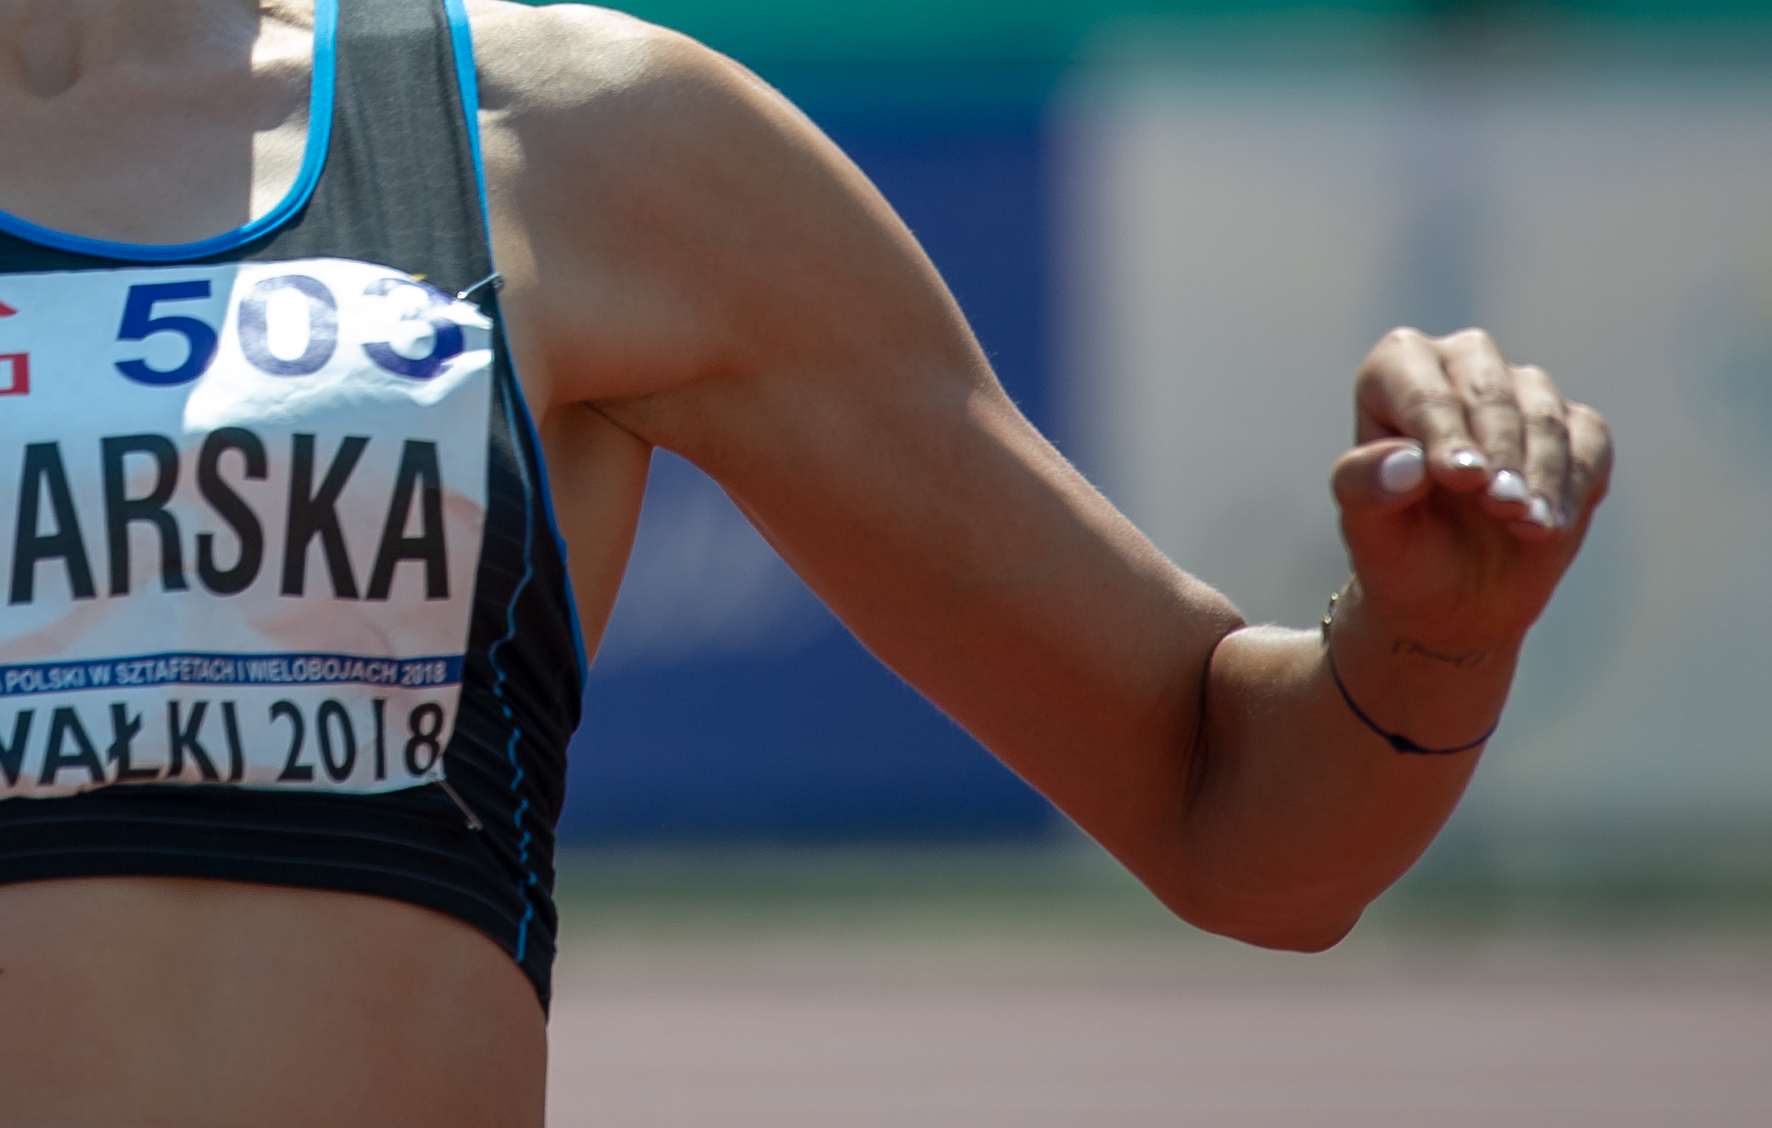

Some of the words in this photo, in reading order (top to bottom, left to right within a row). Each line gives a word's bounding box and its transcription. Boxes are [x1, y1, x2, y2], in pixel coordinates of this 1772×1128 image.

[114, 275, 465, 387] 503
[4, 666, 86, 693] POLSKI
[87, 663, 112, 686] W
[115, 656, 235, 685] SZTAFETACH
[245, 656, 398, 684] WIELOBOJACH
[270, 697, 444, 782] 2018
